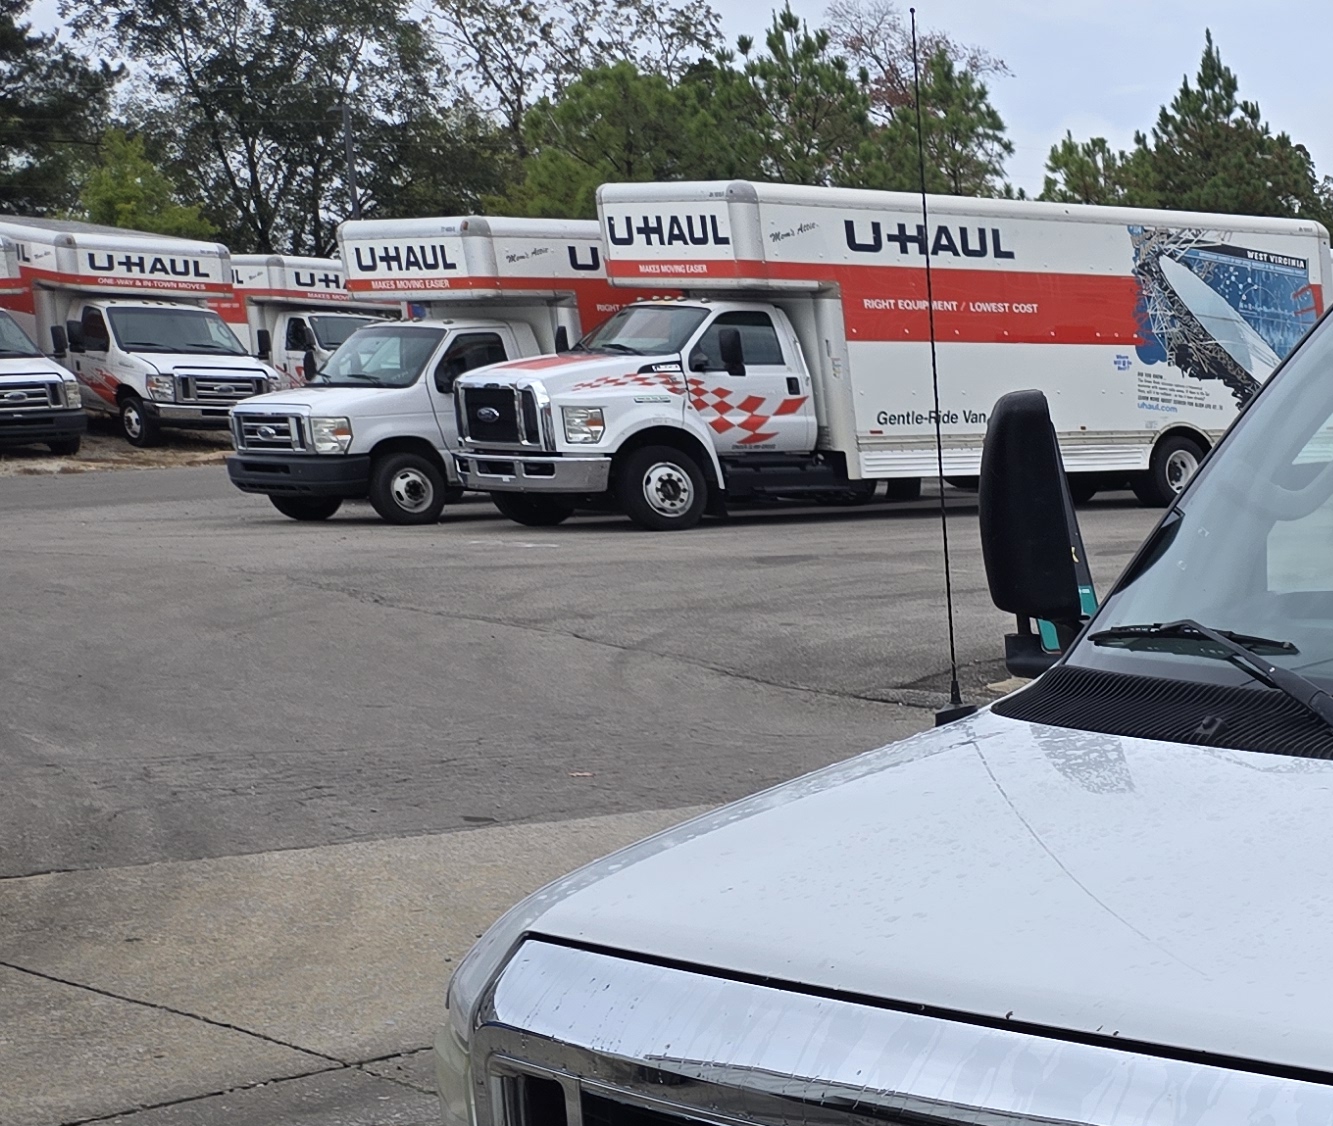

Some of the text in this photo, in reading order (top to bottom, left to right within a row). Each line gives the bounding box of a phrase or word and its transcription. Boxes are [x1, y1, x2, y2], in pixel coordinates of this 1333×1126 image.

[607, 214, 731, 246] U-HAUL
[843, 219, 1015, 259] U-HAUL
[87, 252, 211, 278] U-HAUL
[354, 244, 457, 272] U-HAUL
[1246, 250, 1268, 262] WEST
[1269, 254, 1305, 269] VIRGINIA
[638, 264, 708, 273] MAKES MOVING EASIER
[371, 279, 450, 289] MAKES MOVING EASIER
[863, 299, 895, 310] RIGHT
[969, 302, 1010, 313] LOWEST
[1012, 303, 1038, 314] COST
[1137, 401, 1178, 413] uhaul.com
[962, 409, 987, 424] Van
